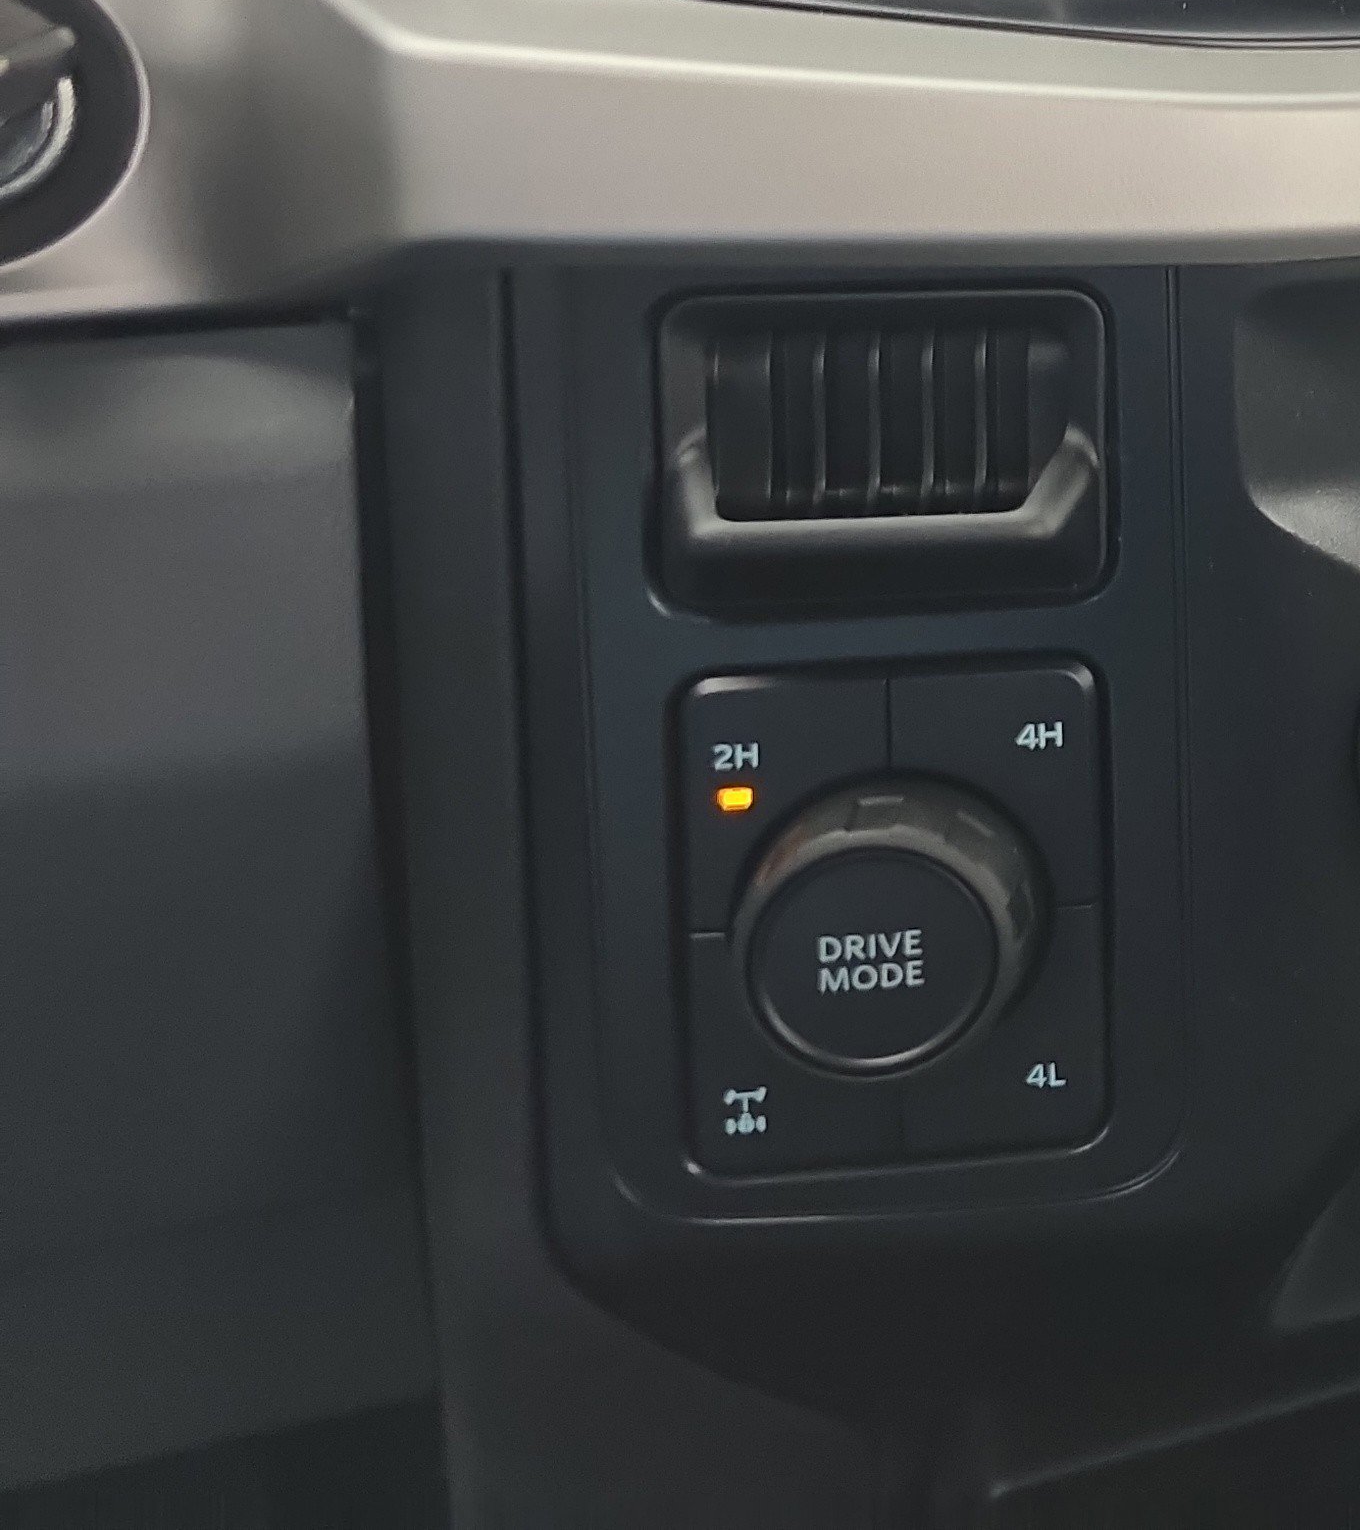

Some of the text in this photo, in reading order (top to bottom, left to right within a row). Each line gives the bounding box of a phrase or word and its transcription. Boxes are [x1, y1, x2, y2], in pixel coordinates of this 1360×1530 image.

[1014, 720, 1064, 750] 4H
[712, 741, 760, 771] 2H
[817, 928, 923, 964] DRIVE
[816, 958, 925, 995] MODE
[1025, 1062, 1067, 1088] 4L
